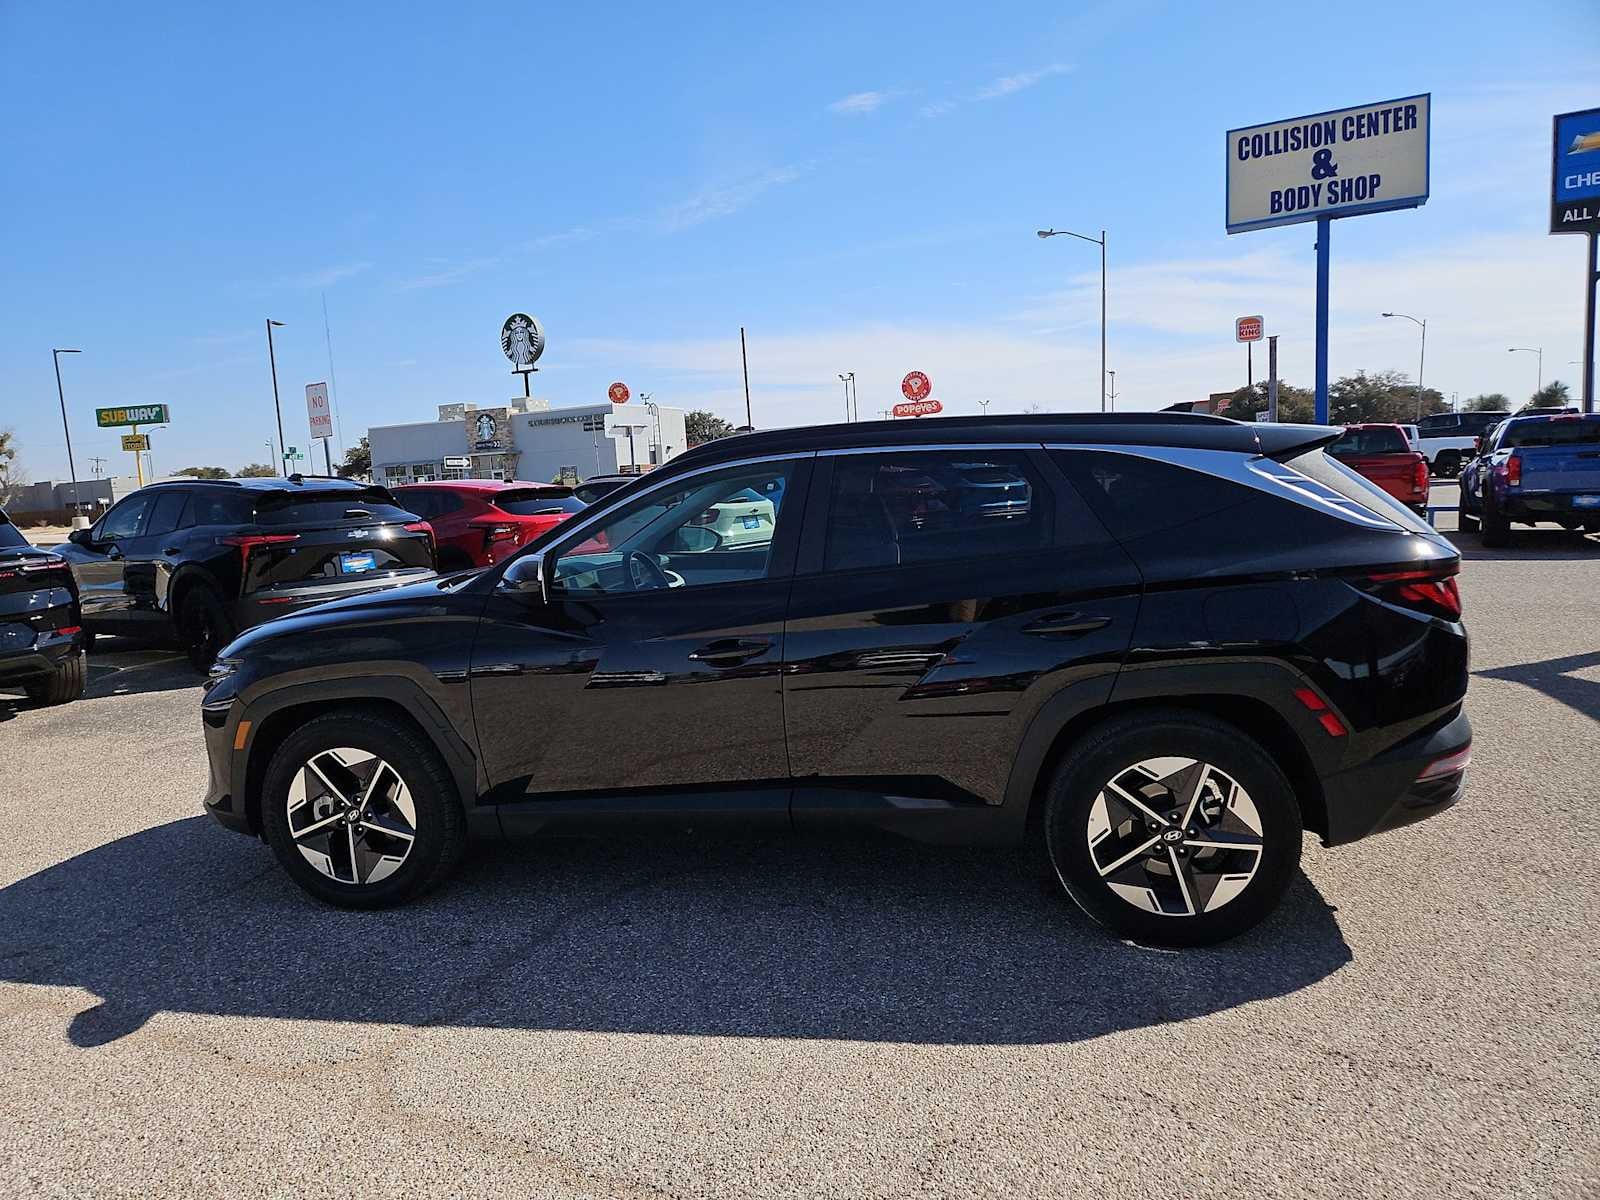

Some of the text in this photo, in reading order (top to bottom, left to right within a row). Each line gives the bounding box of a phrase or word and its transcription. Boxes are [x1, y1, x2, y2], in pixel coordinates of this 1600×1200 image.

[1238, 104, 1417, 161] COLLISION CENTER
[1311, 148, 1338, 180] &
[1270, 174, 1381, 214] BODY SHOP
[1562, 207, 1592, 222] ALL
[311, 396, 323, 408] NO
[101, 407, 160, 424] SUBWAY
